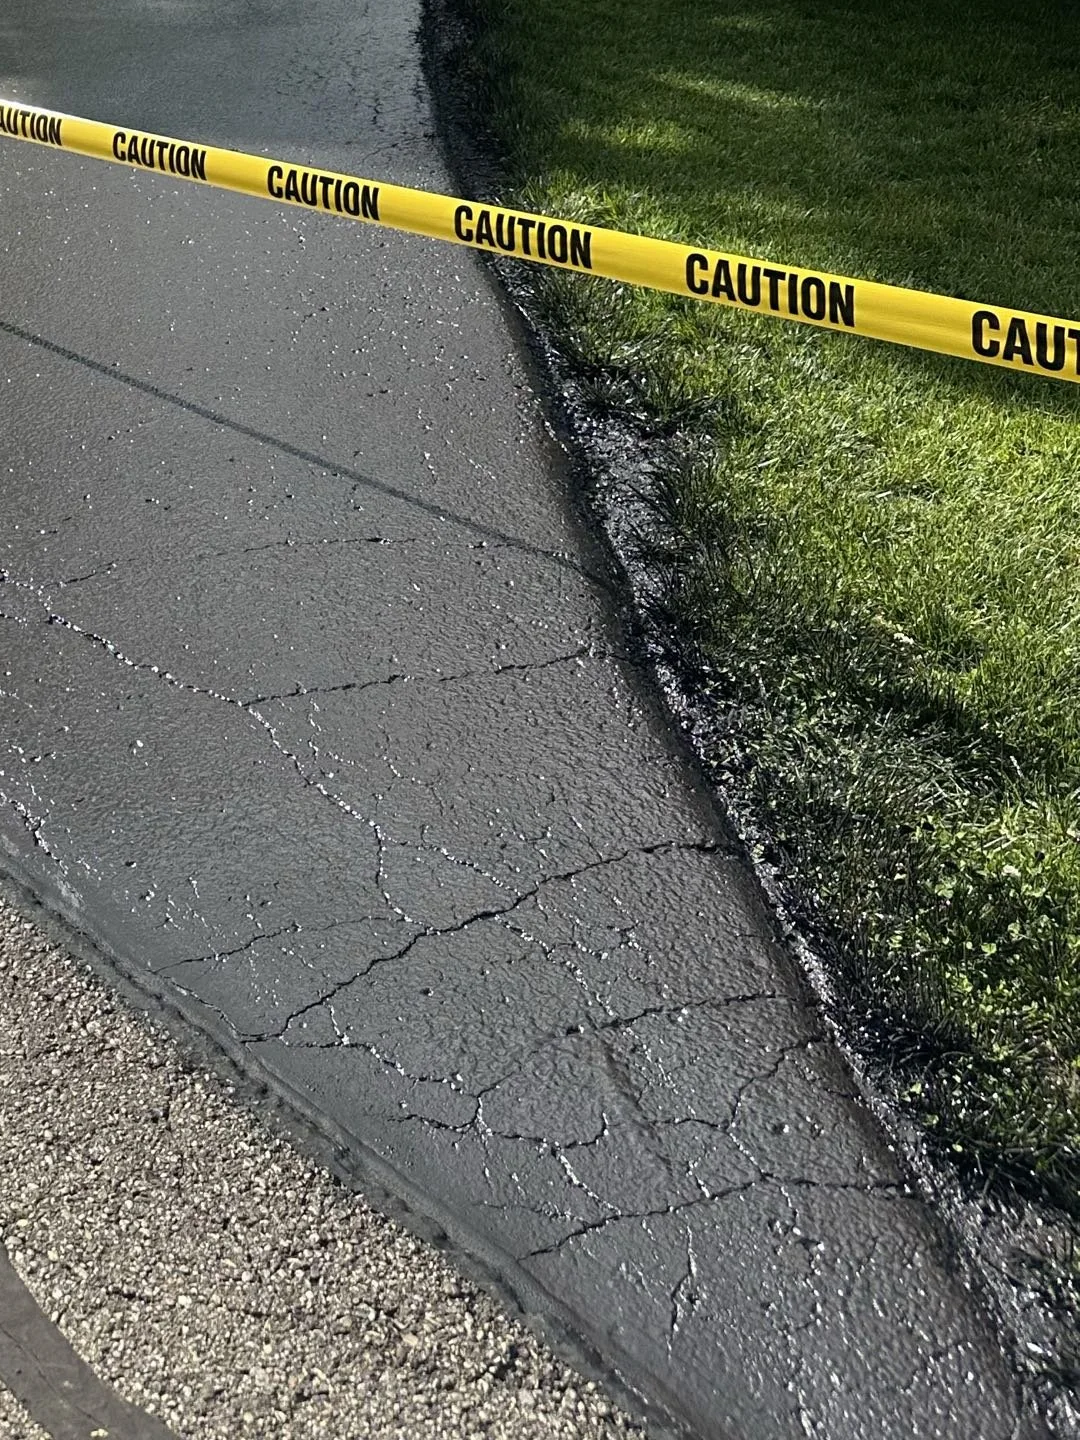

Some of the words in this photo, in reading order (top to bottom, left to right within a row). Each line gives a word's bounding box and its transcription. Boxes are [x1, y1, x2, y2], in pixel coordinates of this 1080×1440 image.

[113, 131, 207, 180] CAUTION
[267, 165, 380, 221] CAUTION
[454, 205, 592, 269] CAUTION
[686, 253, 855, 327] CAUTION
